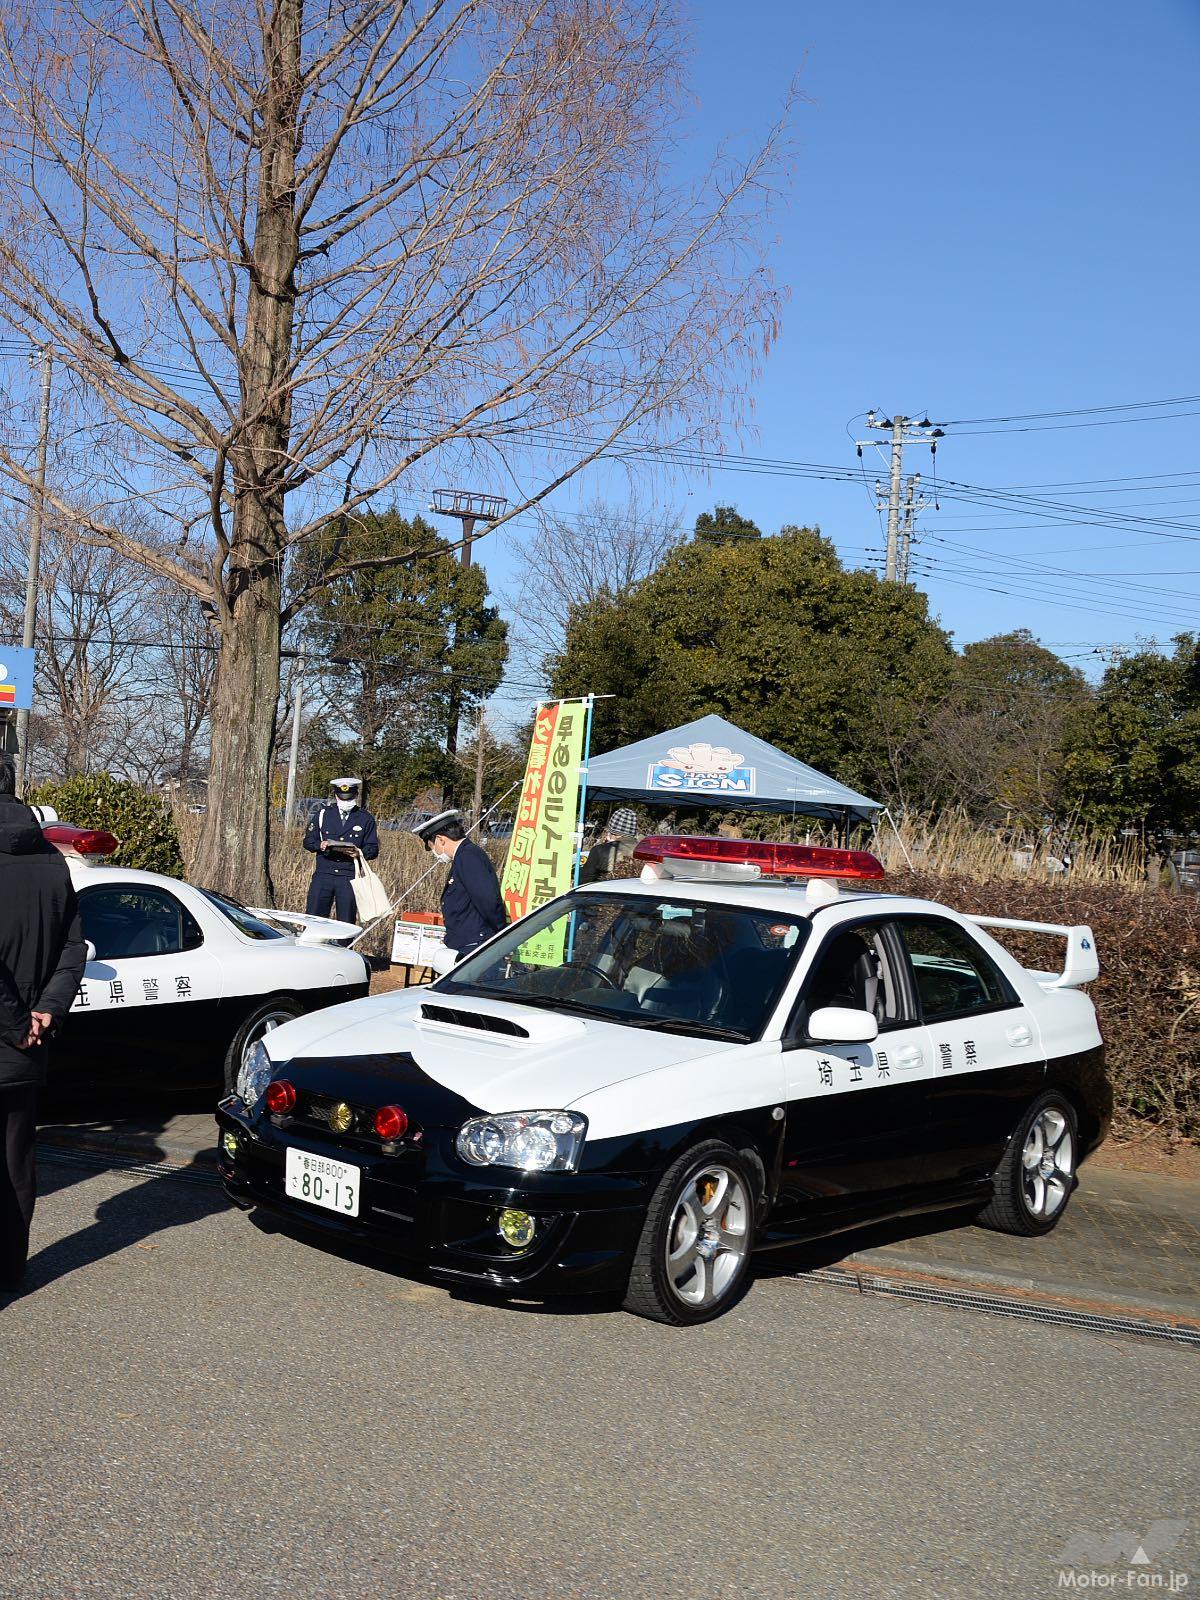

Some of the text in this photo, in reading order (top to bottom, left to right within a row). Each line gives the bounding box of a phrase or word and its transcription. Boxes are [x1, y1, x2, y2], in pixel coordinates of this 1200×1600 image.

[656, 773, 747, 790] SIGN
[817, 1040, 978, 1086] 埼玉県警察
[302, 1172, 354, 1210] 80-13
